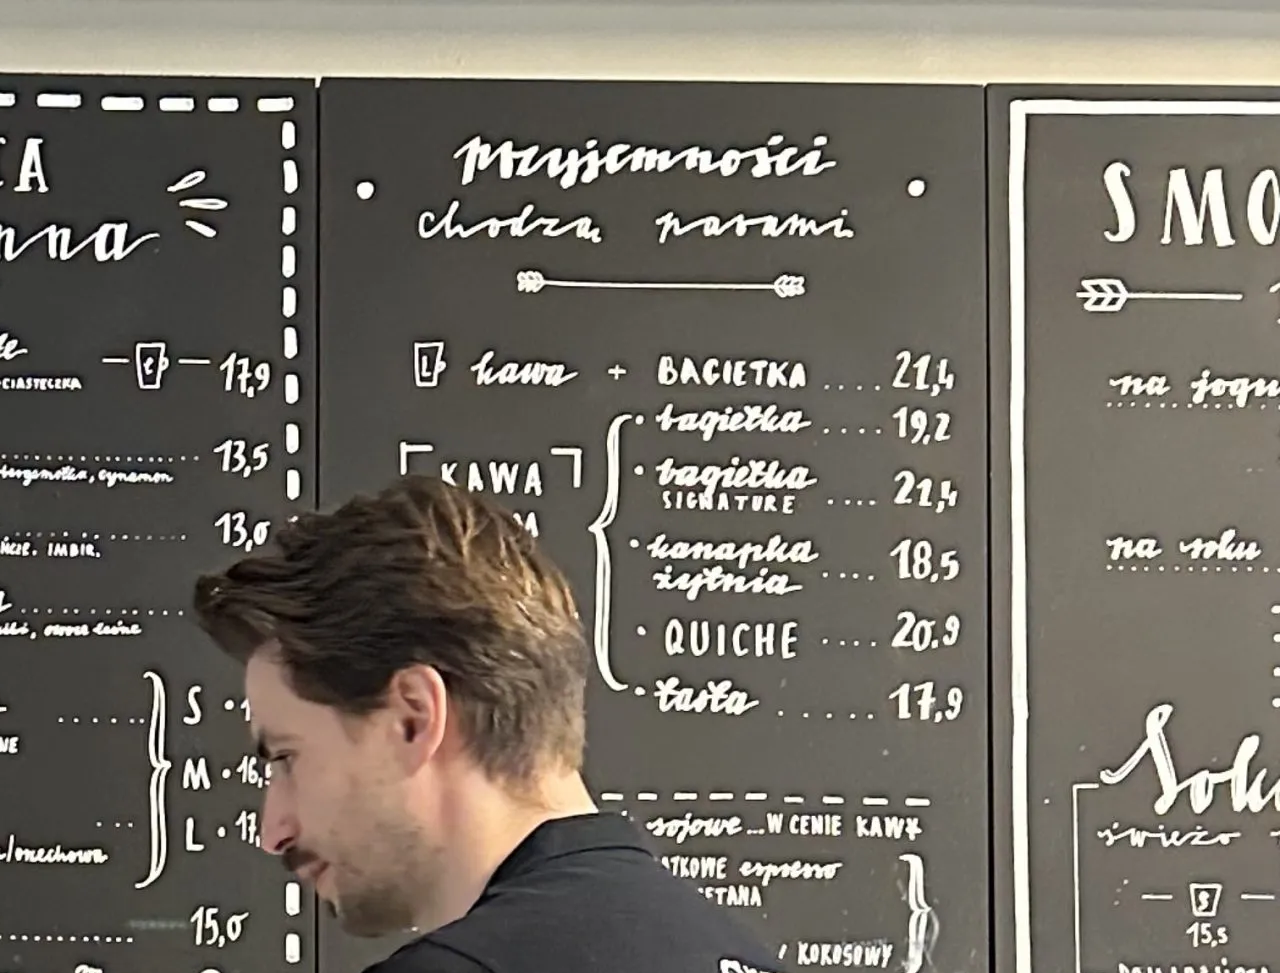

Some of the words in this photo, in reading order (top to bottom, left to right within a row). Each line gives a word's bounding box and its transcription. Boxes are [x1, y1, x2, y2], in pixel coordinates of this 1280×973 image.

[454, 135, 836, 189] przyjemności
[419, 201, 601, 243] chodzą
[656, 210, 853, 243] parami
[220, 353, 269, 397] 17,9
[471, 351, 578, 386] kawa
[892, 351, 953, 396] 21,4
[1110, 376, 1170, 395] na
[656, 404, 811, 441] bagietka
[893, 407, 950, 445] 19,2
[214, 440, 268, 477] 13,5
[442, 462, 542, 496] KAWA
[656, 457, 817, 493] bagietka
[894, 471, 957, 513] 21,4
[662, 492, 796, 515] SIGNATURE
[215, 512, 270, 552] 13,0
[1106, 537, 1162, 560] na
[1180, 529, 1261, 560] soku
[647, 534, 819, 569] kanapka
[890, 540, 959, 582] 18,5
[653, 565, 803, 600] żytnia
[666, 619, 797, 659] QUICHE
[184, 686, 201, 724] S
[654, 677, 759, 715] tarta
[889, 682, 962, 722] 17,9
[183, 758, 210, 789] M
[186, 818, 204, 851] L
[790, 815, 841, 836] CENIE
[857, 816, 922, 840] KAWY
[1097, 822, 1241, 847] świeżo
[739, 861, 842, 886] espresso
[191, 907, 248, 947] 15,0
[1186, 922, 1228, 947] 15,5
[798, 940, 892, 968] KOKOSOWY
